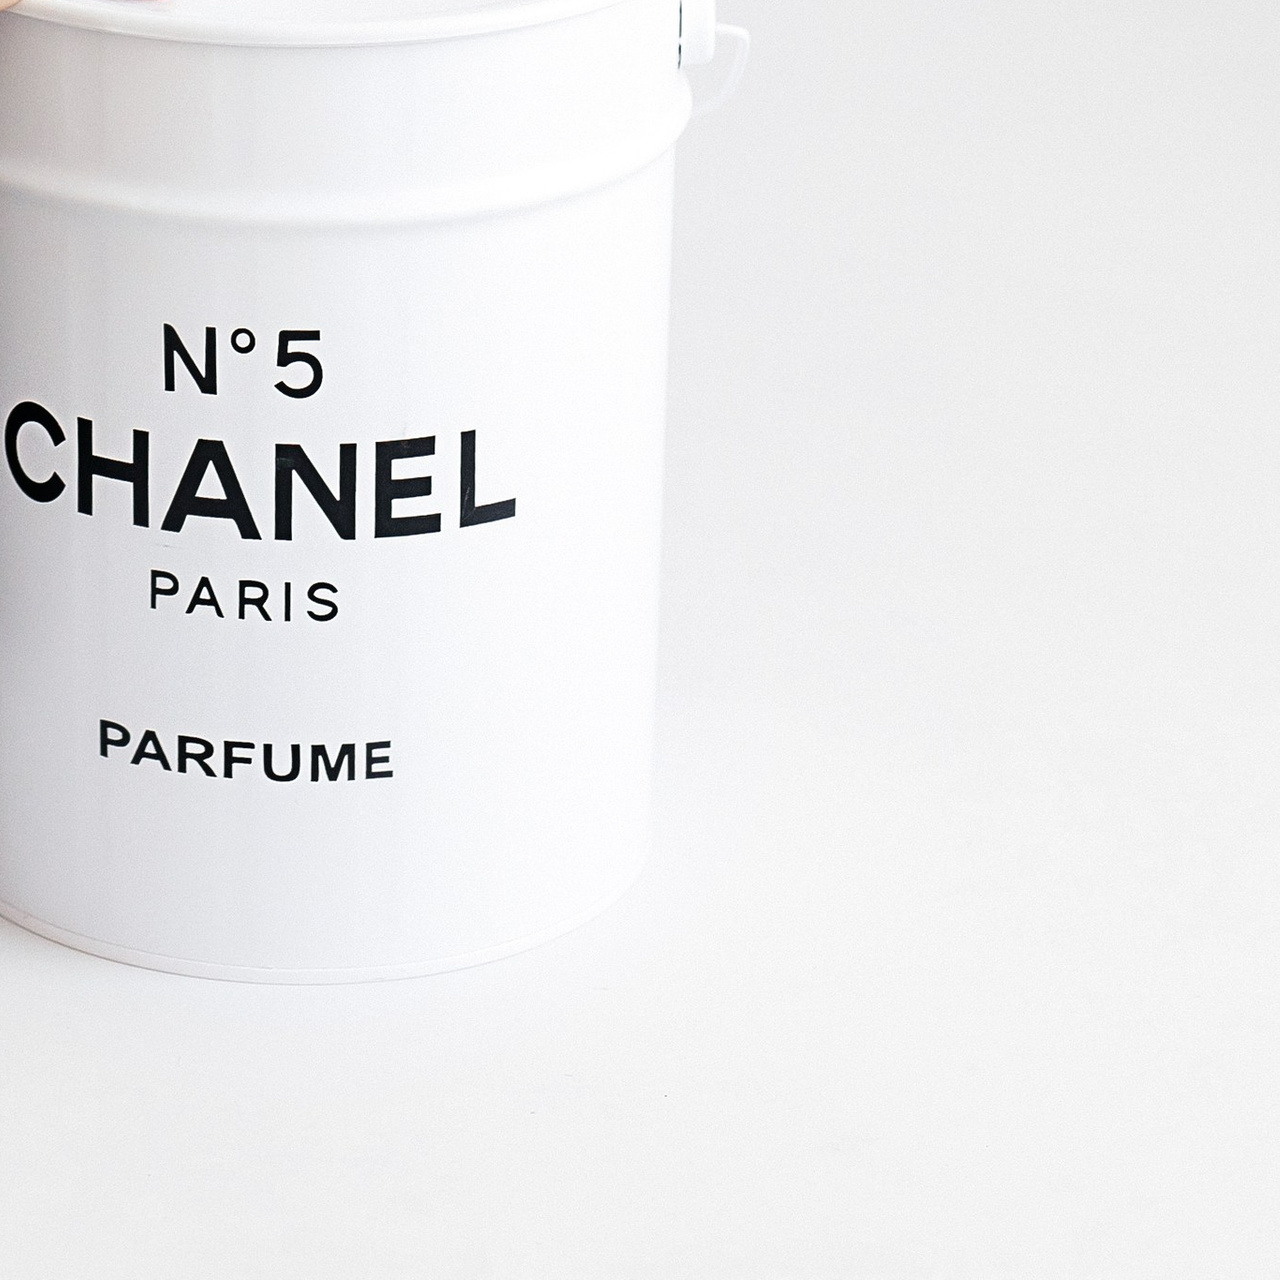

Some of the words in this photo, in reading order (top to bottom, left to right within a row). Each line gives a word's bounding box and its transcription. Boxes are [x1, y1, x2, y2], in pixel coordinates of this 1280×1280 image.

[3, 399, 517, 542] CHANEL
[149, 568, 340, 623] PARIS
[98, 718, 395, 784] PARFUME
